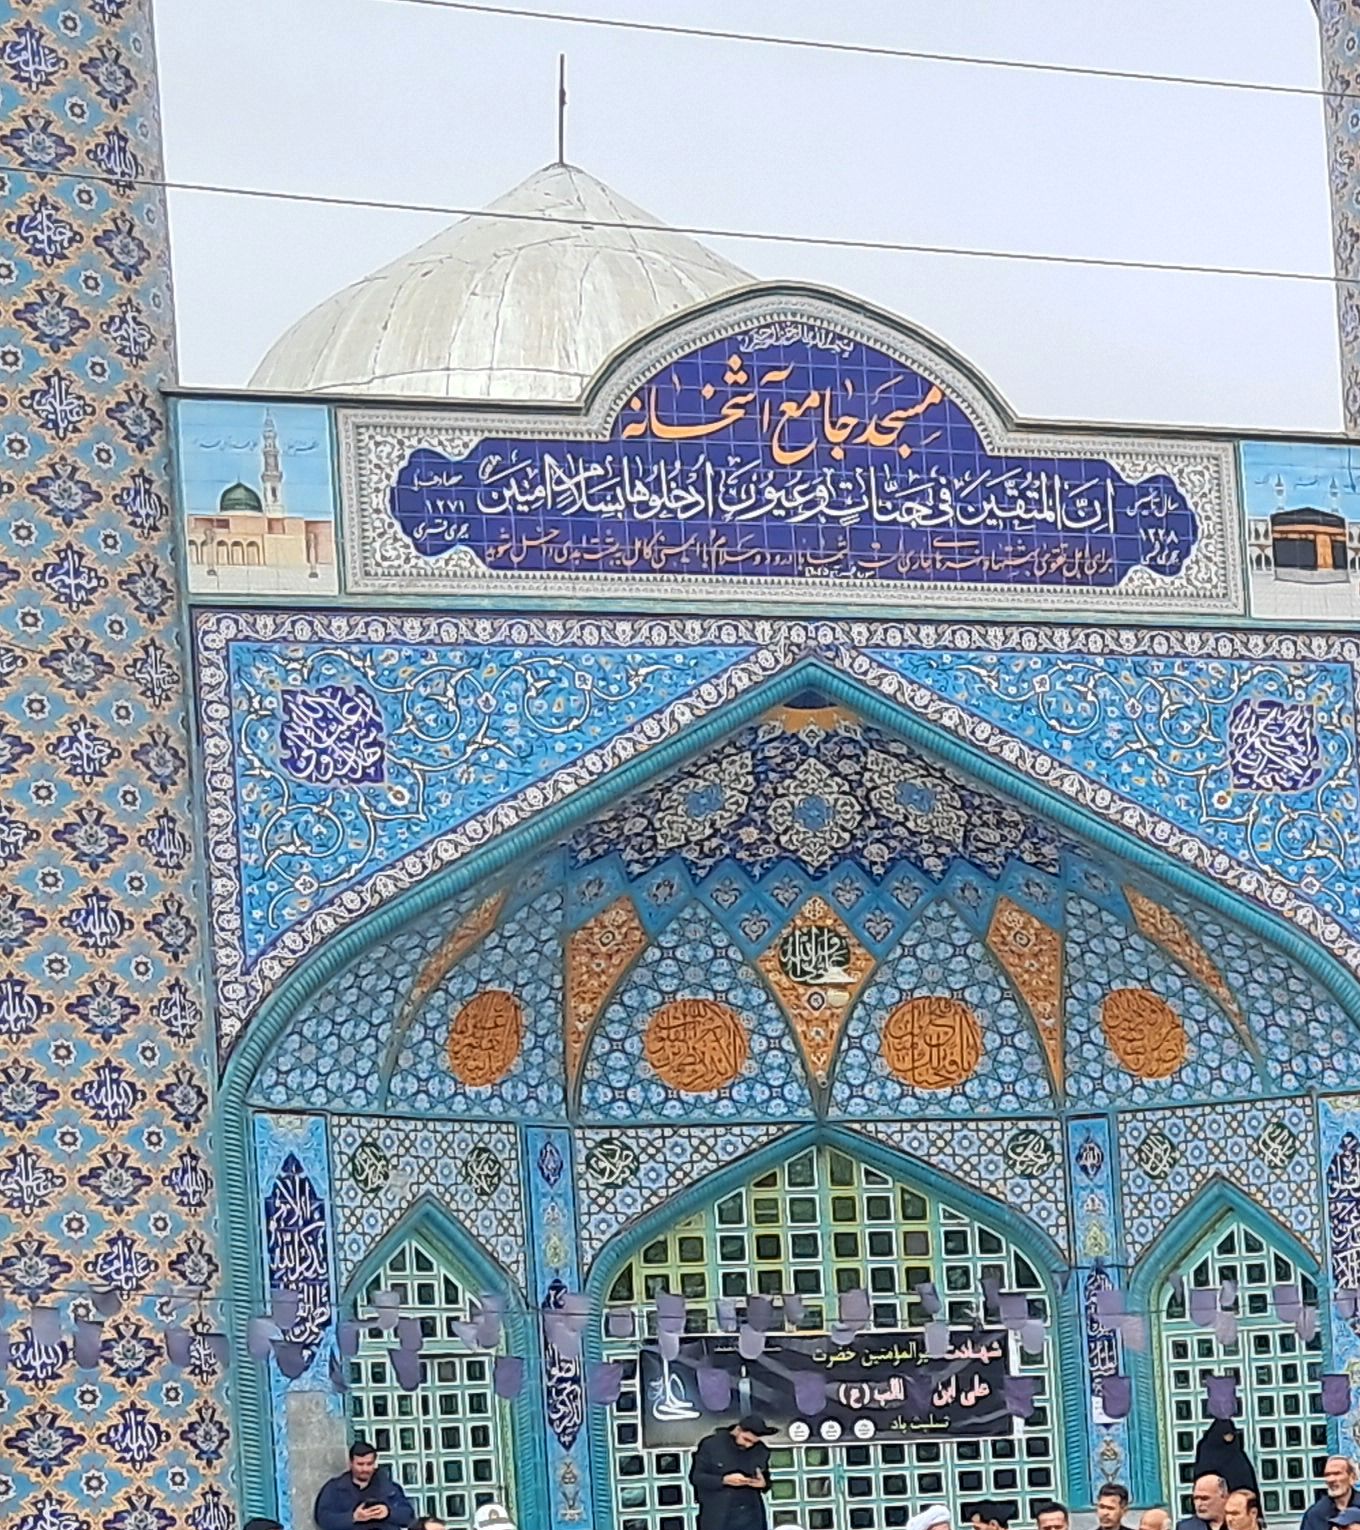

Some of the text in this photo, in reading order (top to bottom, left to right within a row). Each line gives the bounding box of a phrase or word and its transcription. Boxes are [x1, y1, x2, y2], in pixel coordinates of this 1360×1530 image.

[621, 354, 946, 465] مسجد جامع آشخانه
[811, 1346, 857, 1370] حضرت
[931, 1372, 991, 1407] علی ابن
[889, 1414, 950, 1434] تسلیت باد
